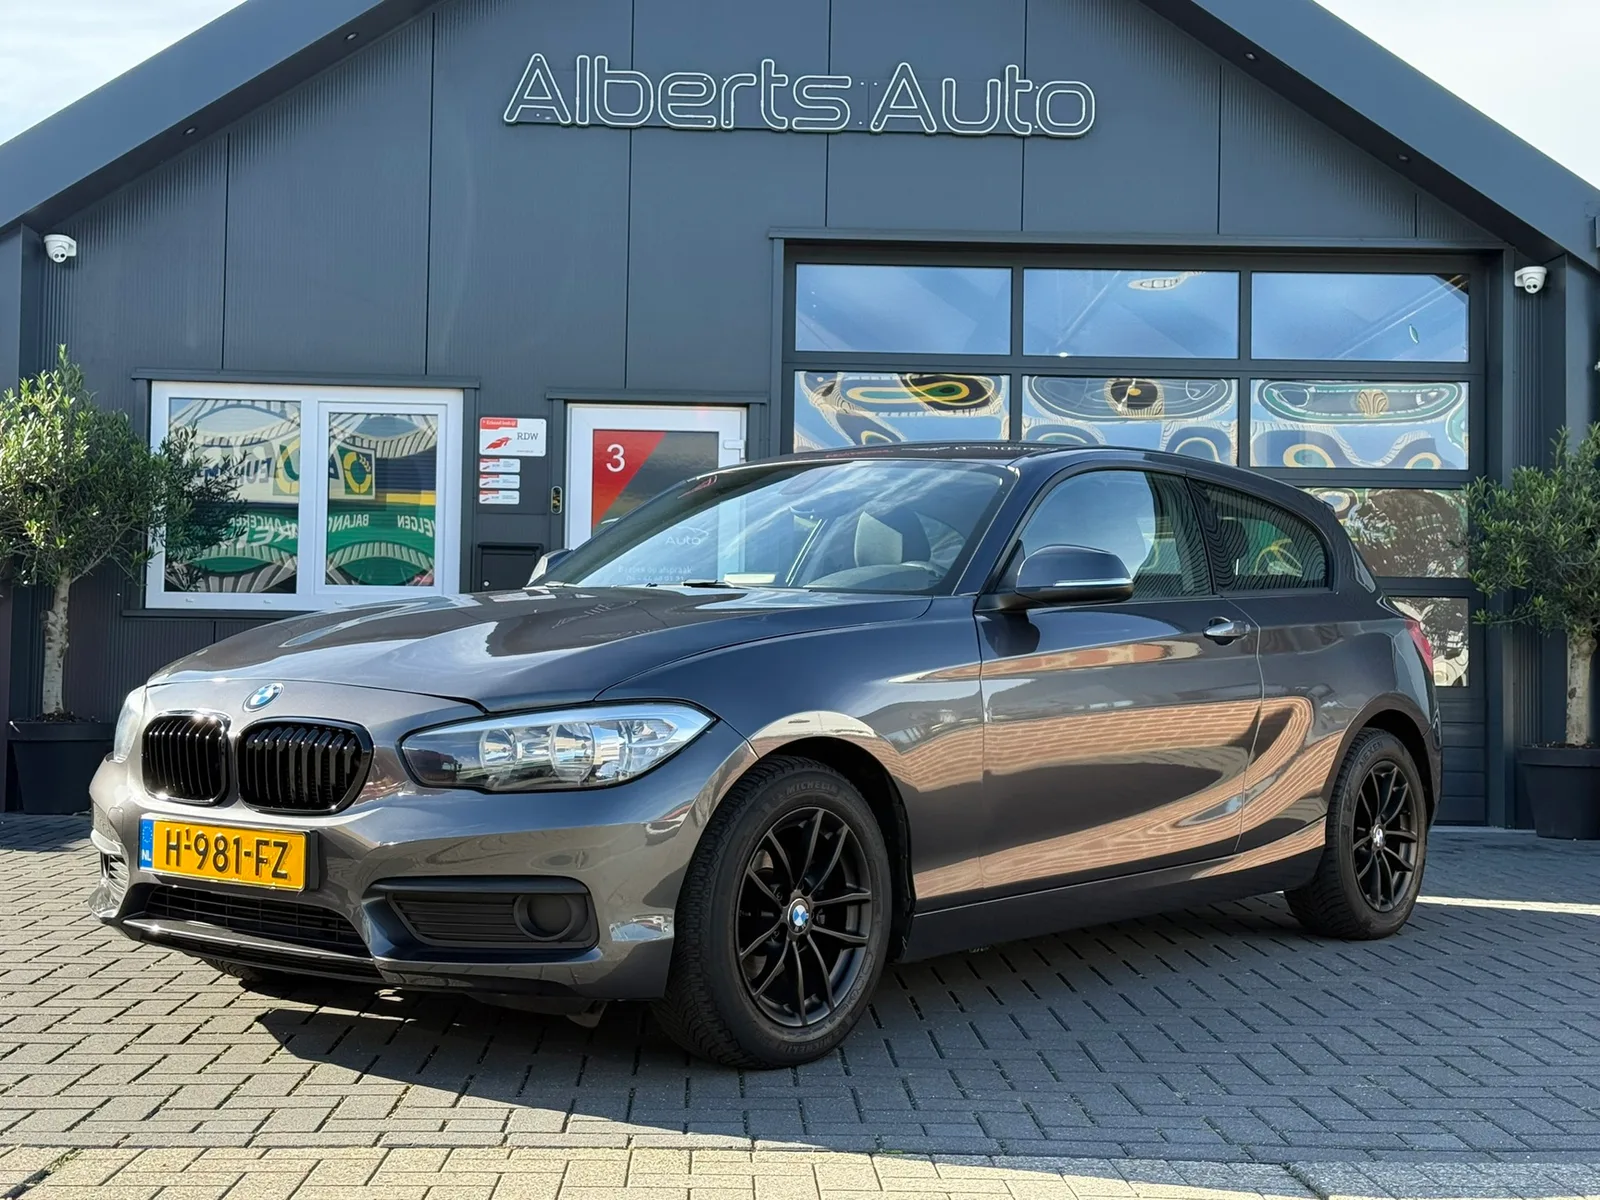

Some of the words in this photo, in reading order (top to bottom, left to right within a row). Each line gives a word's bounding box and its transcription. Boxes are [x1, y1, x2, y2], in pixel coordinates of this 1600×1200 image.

[503, 53, 852, 132] Alberts
[869, 62, 1096, 137] Auto
[517, 432, 539, 441] RDW
[605, 443, 626, 473] 3
[665, 536, 701, 546] Auto
[786, 781, 839, 796] MICHELIN
[141, 850, 152, 862] NL
